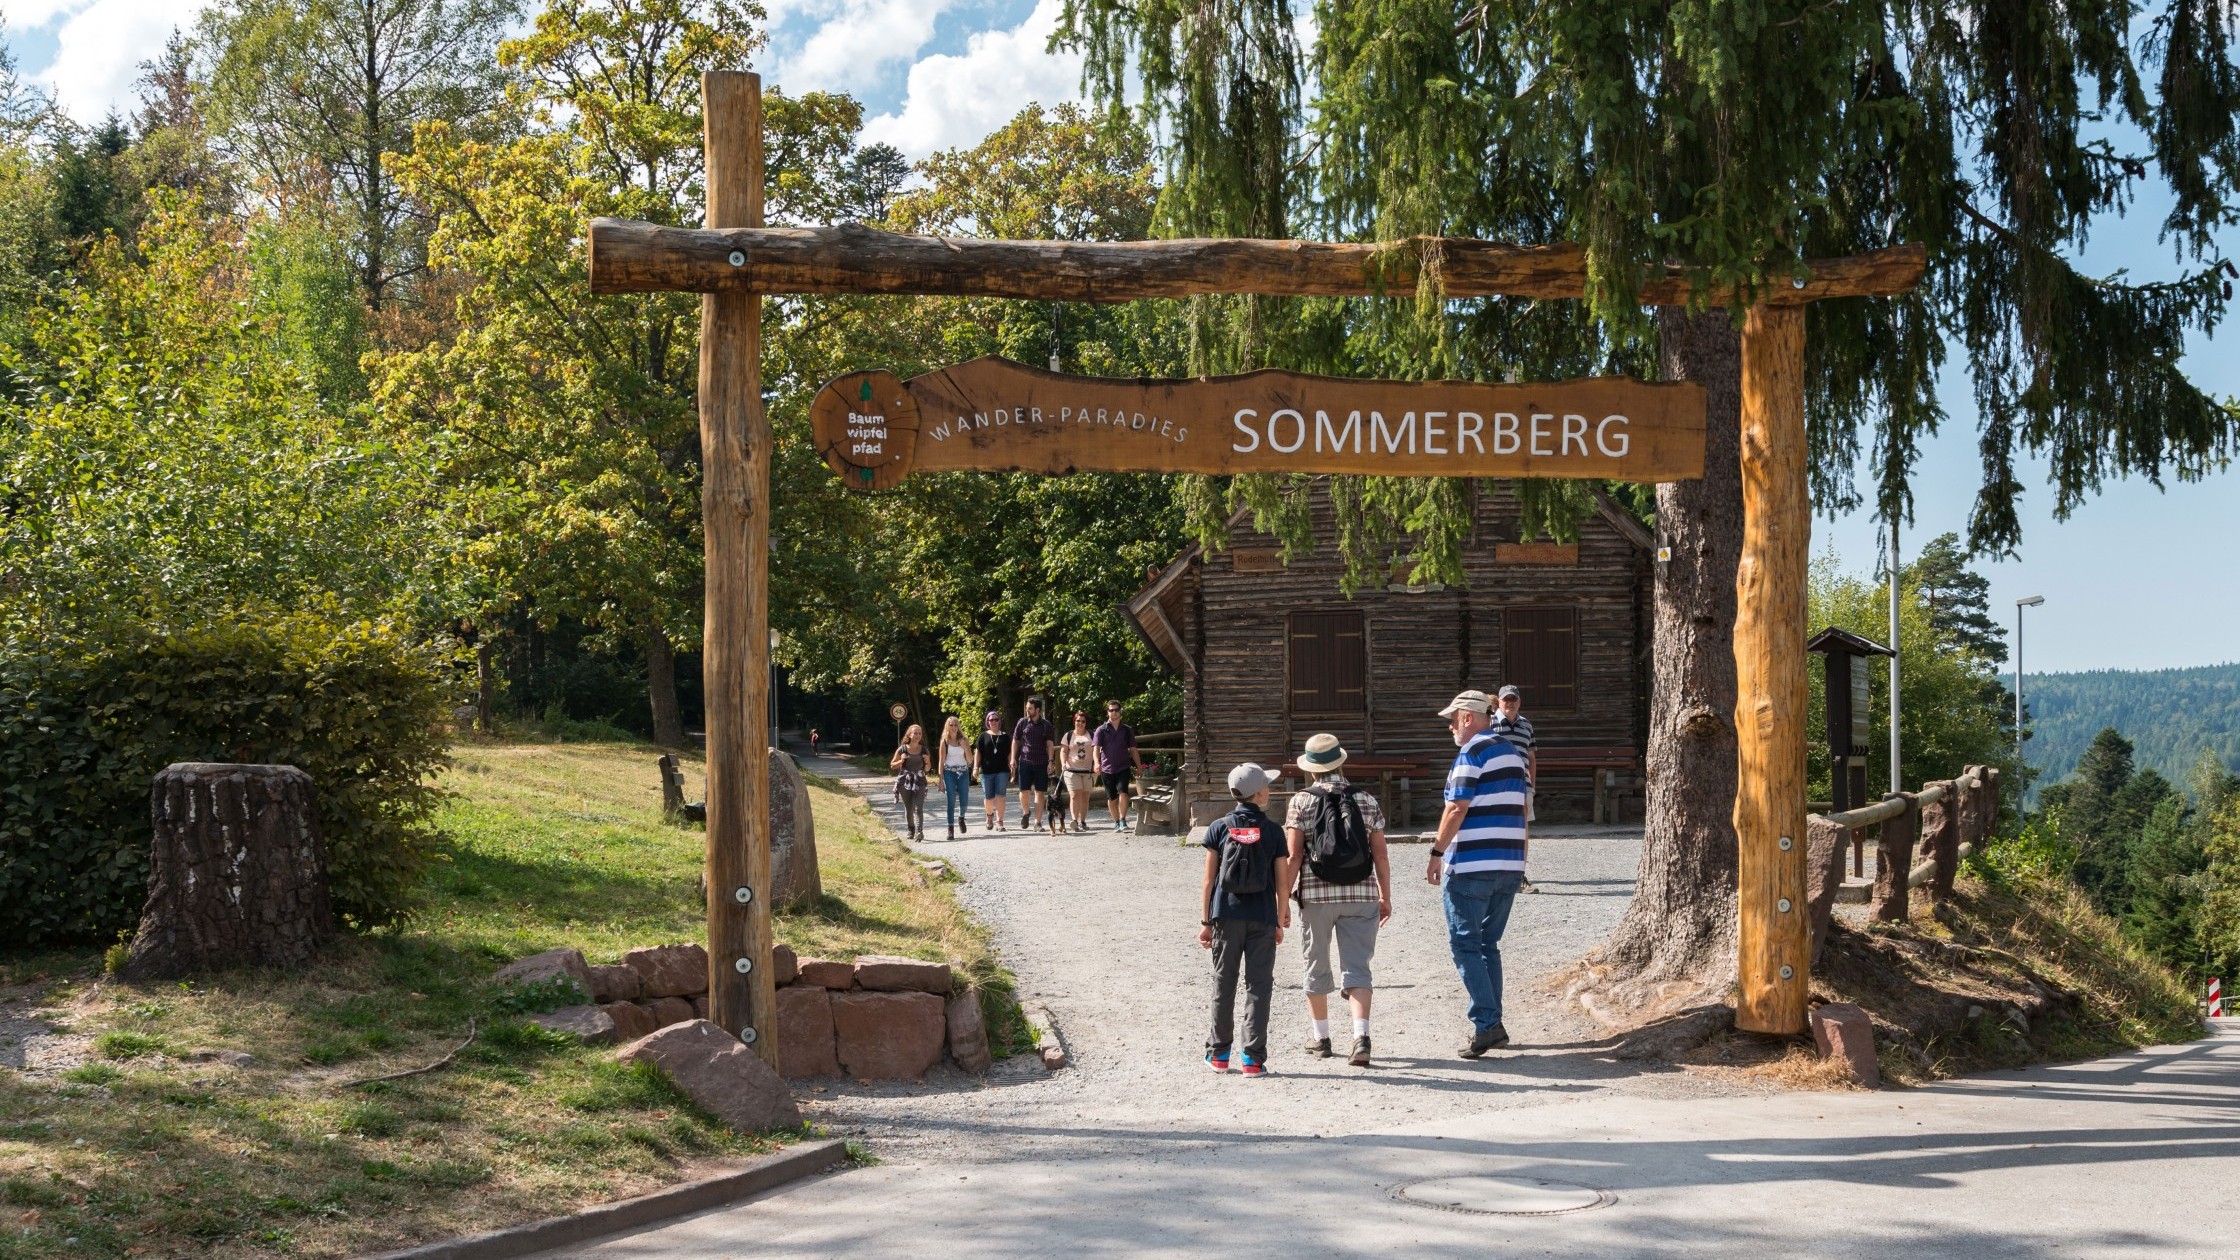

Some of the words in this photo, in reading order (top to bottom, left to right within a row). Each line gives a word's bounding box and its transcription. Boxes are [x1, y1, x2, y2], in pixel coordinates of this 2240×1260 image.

[848, 412, 885, 425] Baum
[929, 406, 1189, 443] WANDER-PARADIES
[846, 427, 888, 440] wipfel
[1232, 408, 1630, 458] SOMMERBERG
[852, 441, 882, 456] pfad
